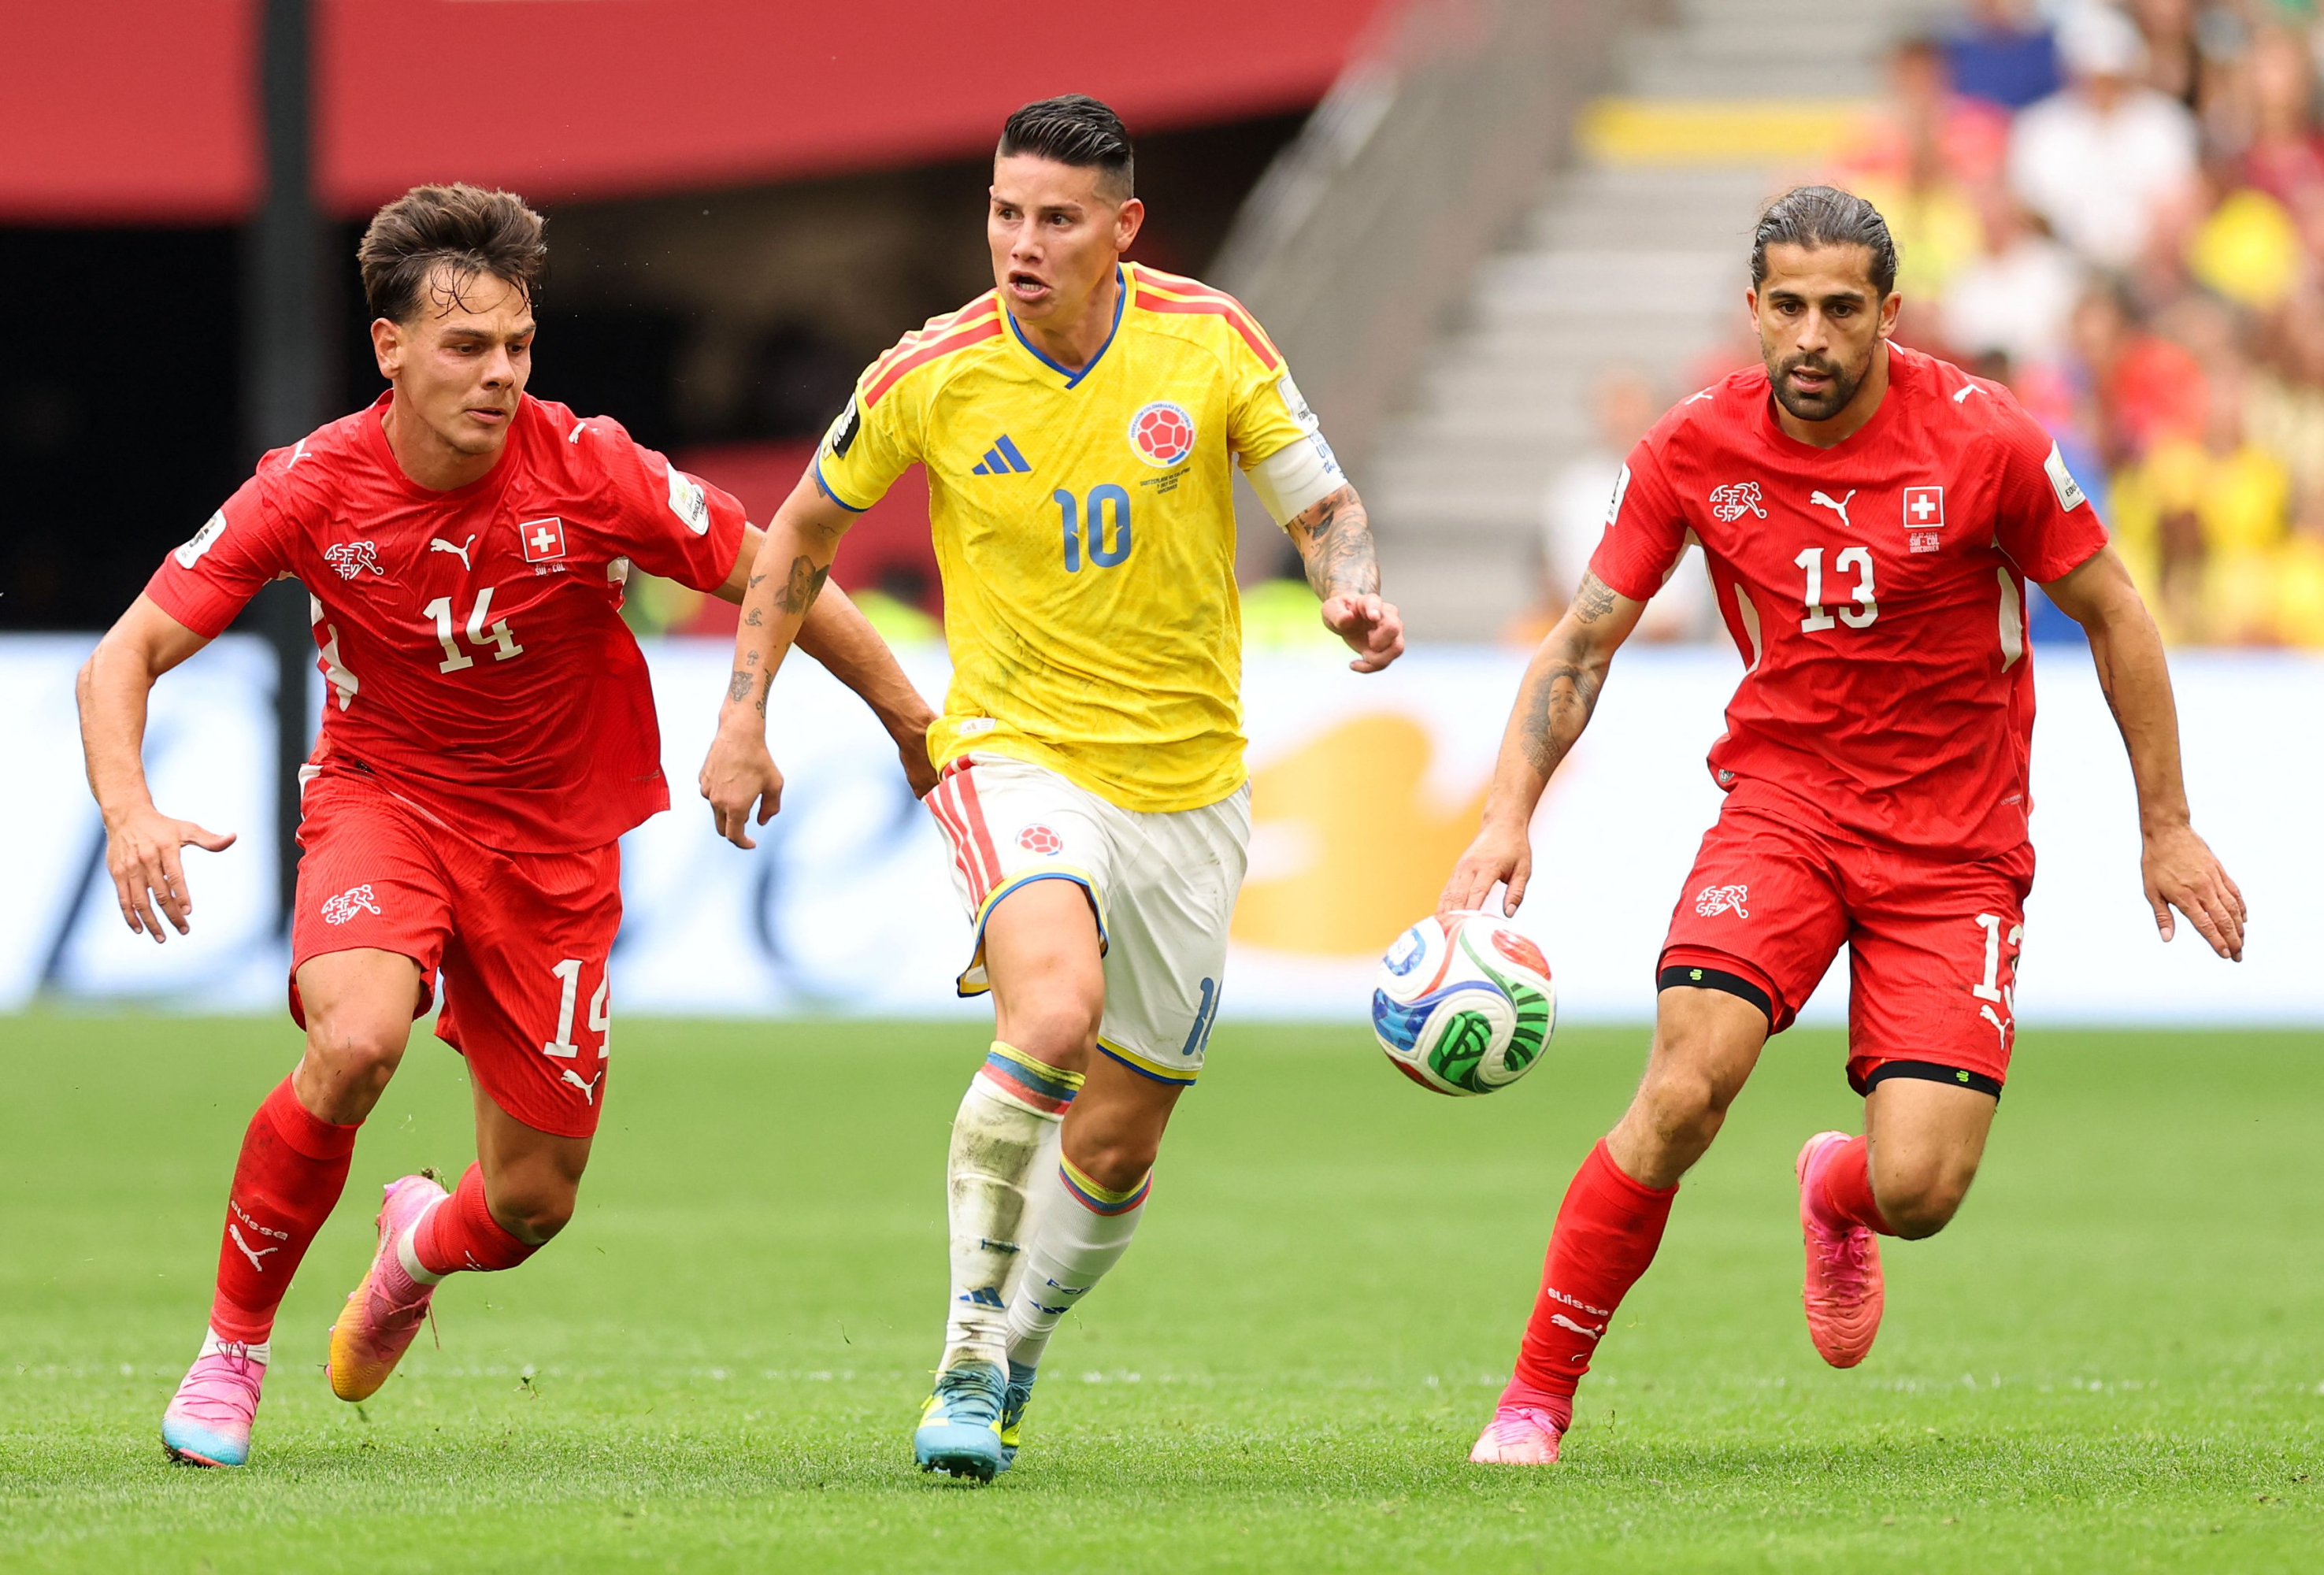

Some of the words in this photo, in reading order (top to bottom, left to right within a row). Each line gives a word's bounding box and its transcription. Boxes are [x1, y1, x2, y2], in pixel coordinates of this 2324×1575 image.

[536, 566, 547, 576] SUI
[553, 562, 565, 573] COL
[1054, 484, 1132, 573] 10
[1926, 536, 1940, 545] COL
[422, 587, 524, 674] 14
[1794, 547, 1878, 633] 13
[543, 958, 610, 1059] 14
[1547, 1287, 1608, 1316] suisse
